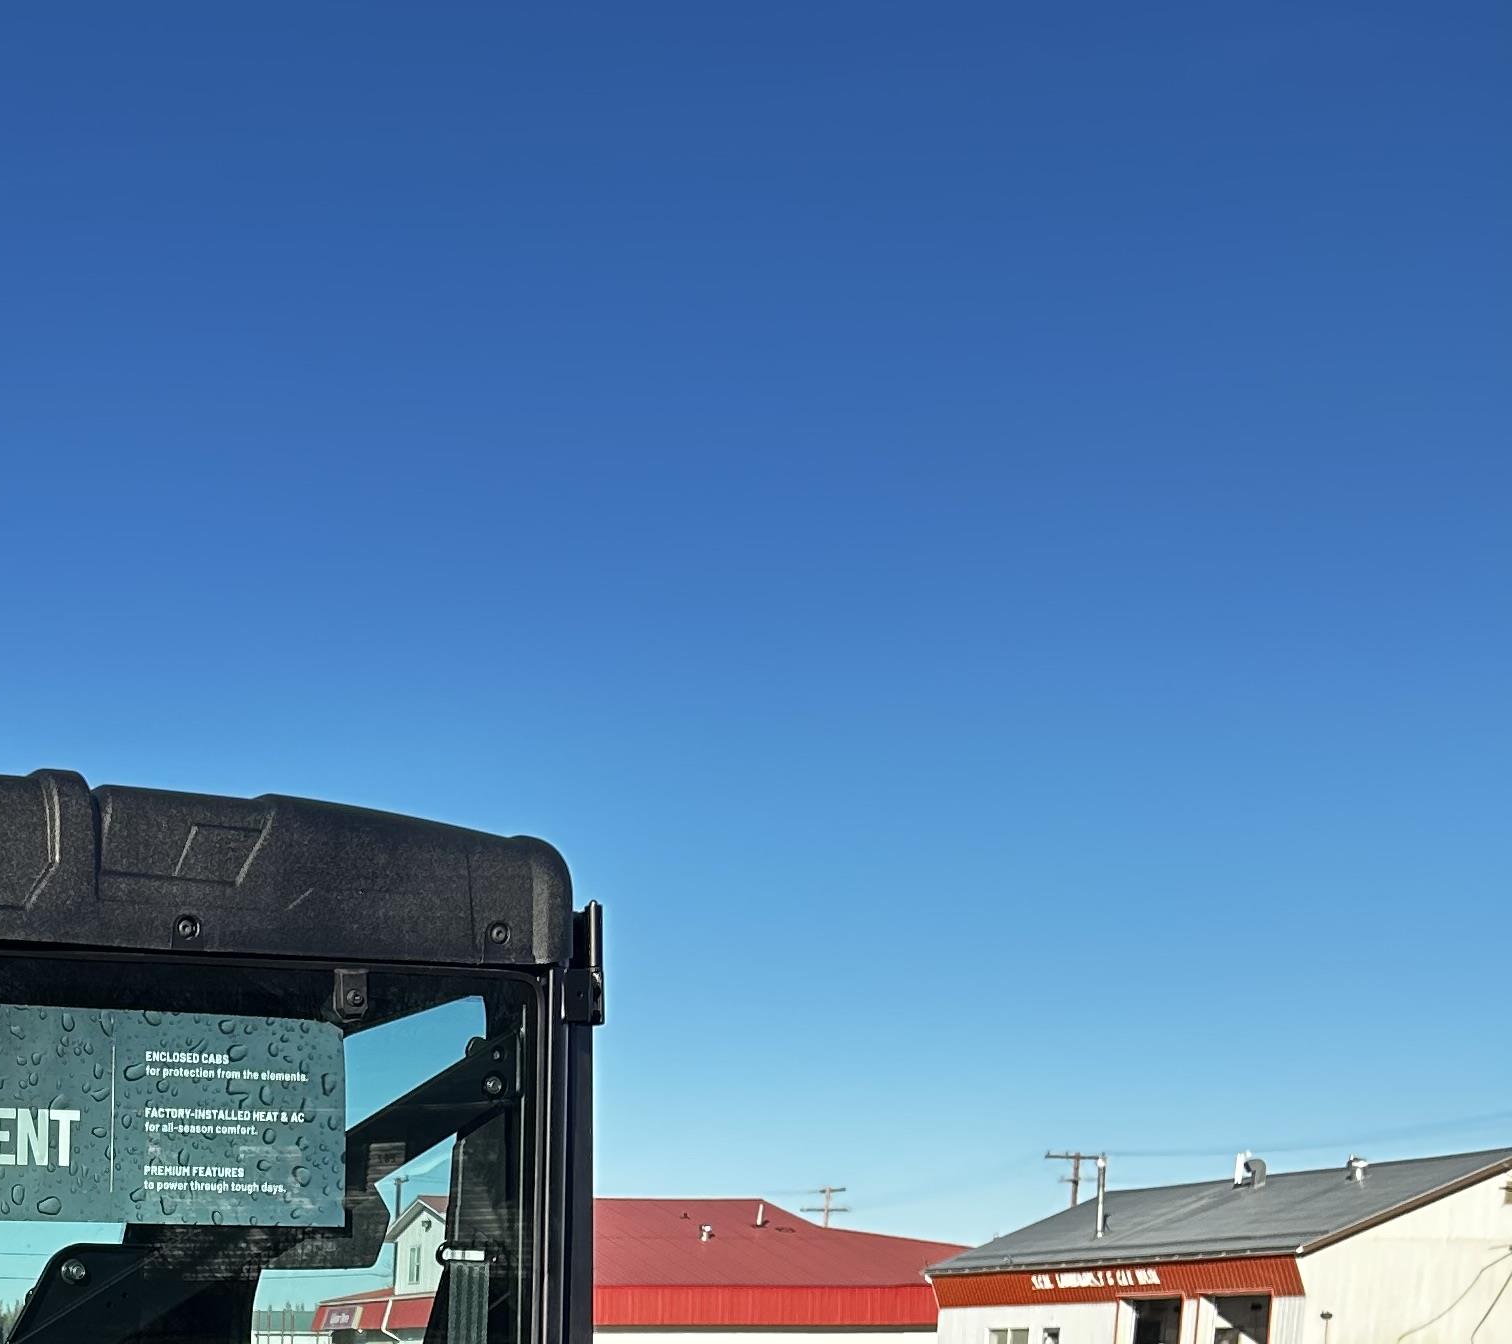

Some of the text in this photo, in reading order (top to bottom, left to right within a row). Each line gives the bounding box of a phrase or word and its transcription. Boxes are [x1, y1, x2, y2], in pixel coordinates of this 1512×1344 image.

[145, 1051, 230, 1065] ENCLOSED CABS
[145, 1065, 309, 1082] for protection from the elements.
[144, 1107, 305, 1123] FACTORY-INSTALLED HEAT & AC
[144, 1121, 259, 1135] for all-season comfort.
[143, 1165, 245, 1178] PREMIUM FEATURES
[143, 1179, 155, 1189] to
[156, 1181, 188, 1192] power
[189, 1180, 229, 1194] through
[230, 1182, 260, 1194] tough
